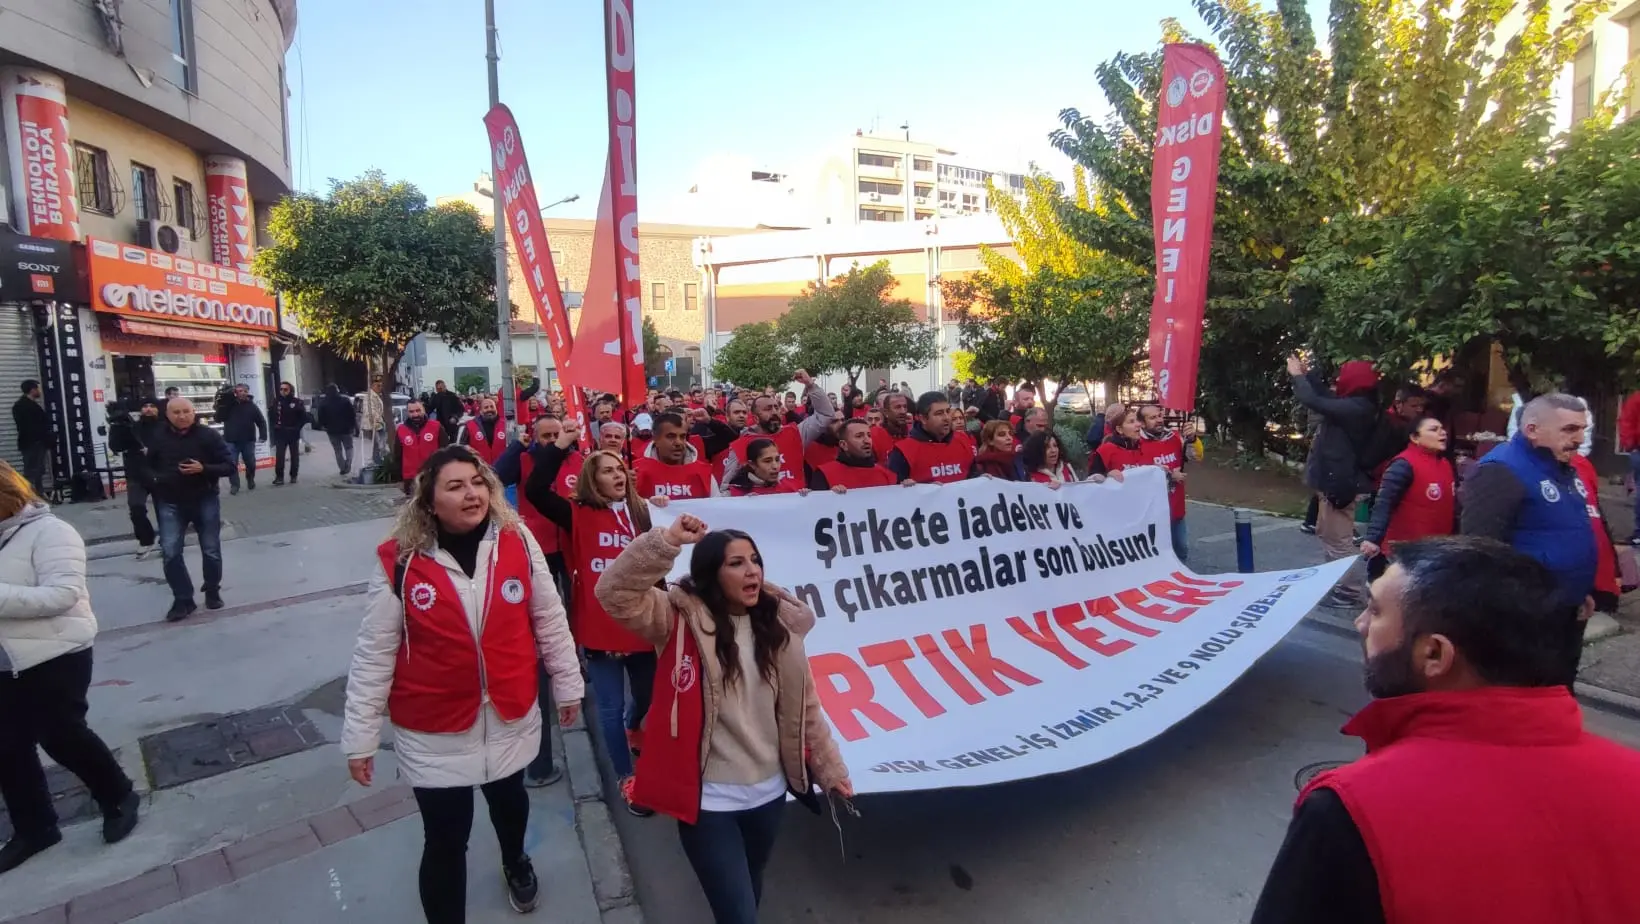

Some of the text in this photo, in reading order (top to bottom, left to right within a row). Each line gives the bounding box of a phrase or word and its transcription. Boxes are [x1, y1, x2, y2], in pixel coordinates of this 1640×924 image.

[21, 120, 48, 226] TEKNOLOJİ
[40, 127, 63, 225] BURADA
[209, 194, 221, 264] EKNOLOJİ
[217, 195, 231, 267] BURADA
[17, 261, 61, 273] SONY
[64, 323, 78, 357] CAM
[931, 463, 962, 478] DİSK
[654, 481, 692, 496] DİSK
[599, 529, 632, 548] DİS
[814, 493, 1083, 569] Şirkete iadeler ve
[834, 546, 1027, 622] çıkarmalar
[1033, 544, 1077, 578] son
[1072, 523, 1160, 572] bulsun!
[807, 570, 1245, 742] RTIK YETER!
[1188, 628, 1243, 662] NOLU
[1152, 667, 1190, 686] VE
[1177, 660, 1201, 671] 9
[1110, 683, 1164, 713] 1,2,3
[1041, 708, 1121, 741] İZMİR
[936, 733, 1058, 770] GENEL-İŞ
